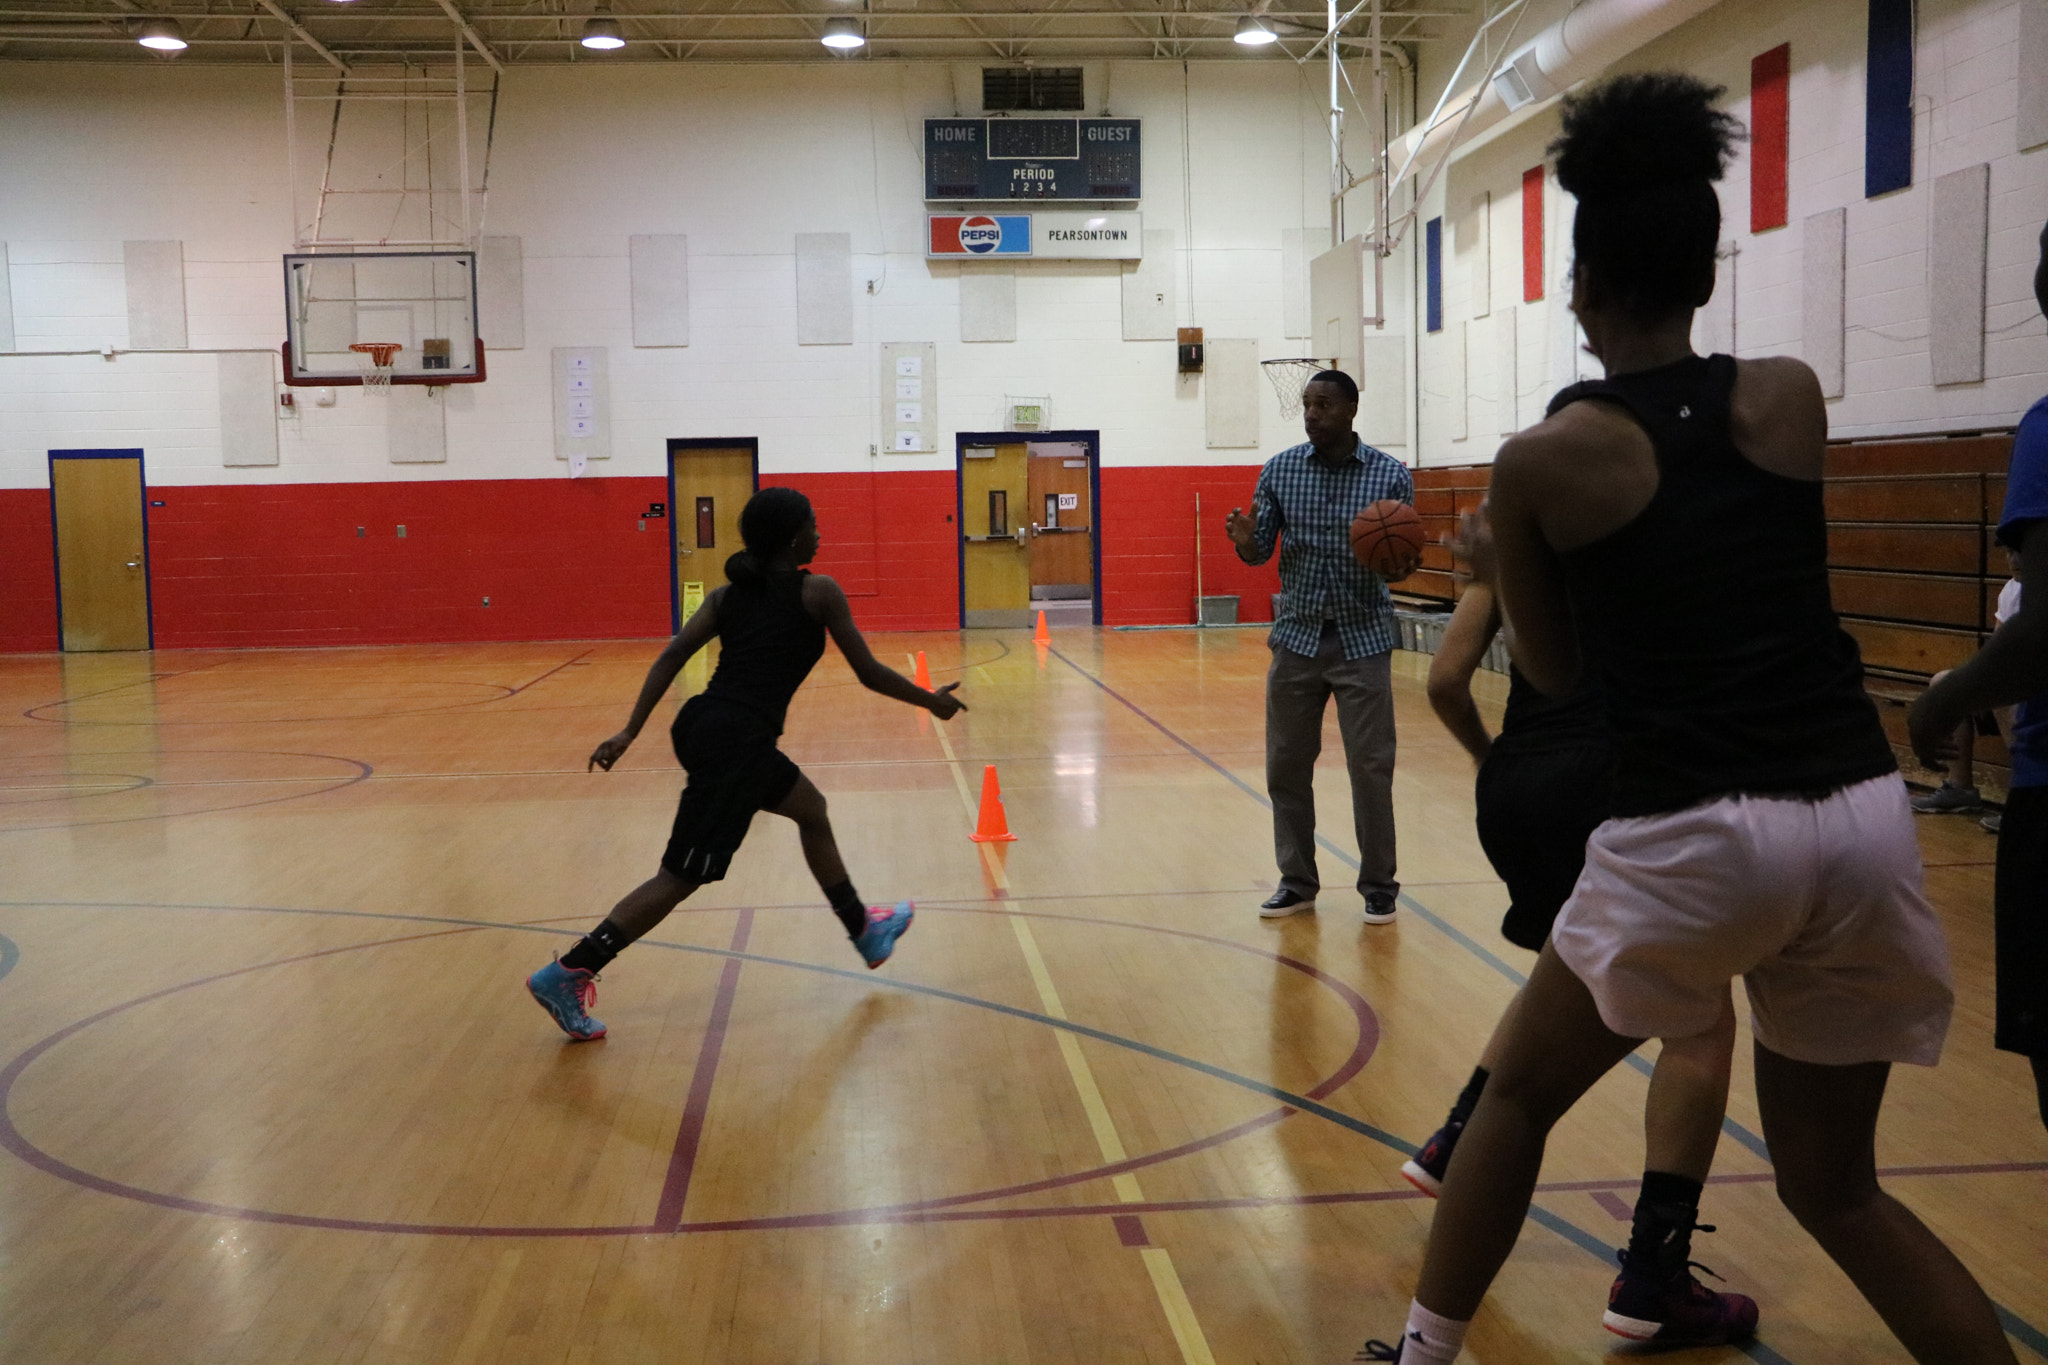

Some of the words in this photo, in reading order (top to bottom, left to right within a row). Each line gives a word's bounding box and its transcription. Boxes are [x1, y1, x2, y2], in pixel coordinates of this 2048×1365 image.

[934, 127, 976, 141] HOME
[1087, 127, 1132, 141] GUEST
[1013, 168, 1055, 180] PERIOD
[1010, 182, 1015, 191] 1
[1023, 182, 1029, 191] 2
[1037, 182, 1043, 191] 3
[1050, 182, 1056, 191] 4
[961, 230, 1000, 240] PEPSI
[1049, 230, 1128, 241] PEARSONTOWN
[1060, 497, 1075, 506] EXIT
